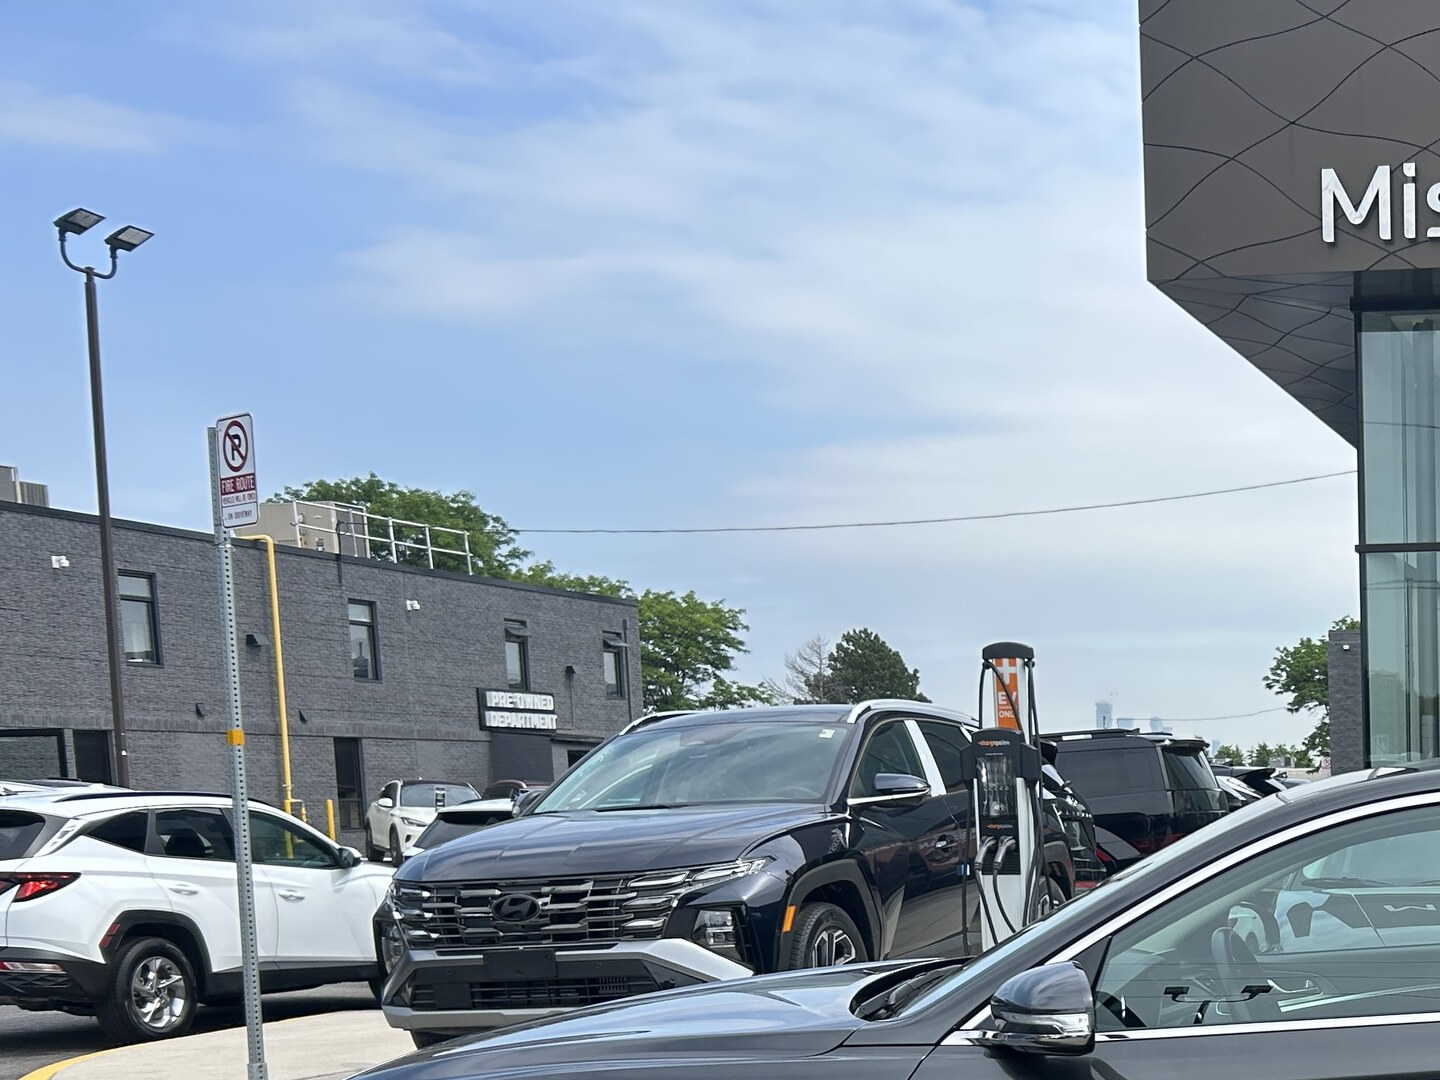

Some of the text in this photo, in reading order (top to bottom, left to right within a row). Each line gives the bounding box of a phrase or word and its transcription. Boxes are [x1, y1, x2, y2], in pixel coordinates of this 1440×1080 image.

[486, 691, 554, 710] PRE-OWNED
[485, 711, 557, 729] DEPARTMENT
[999, 710, 1016, 718] ONL
